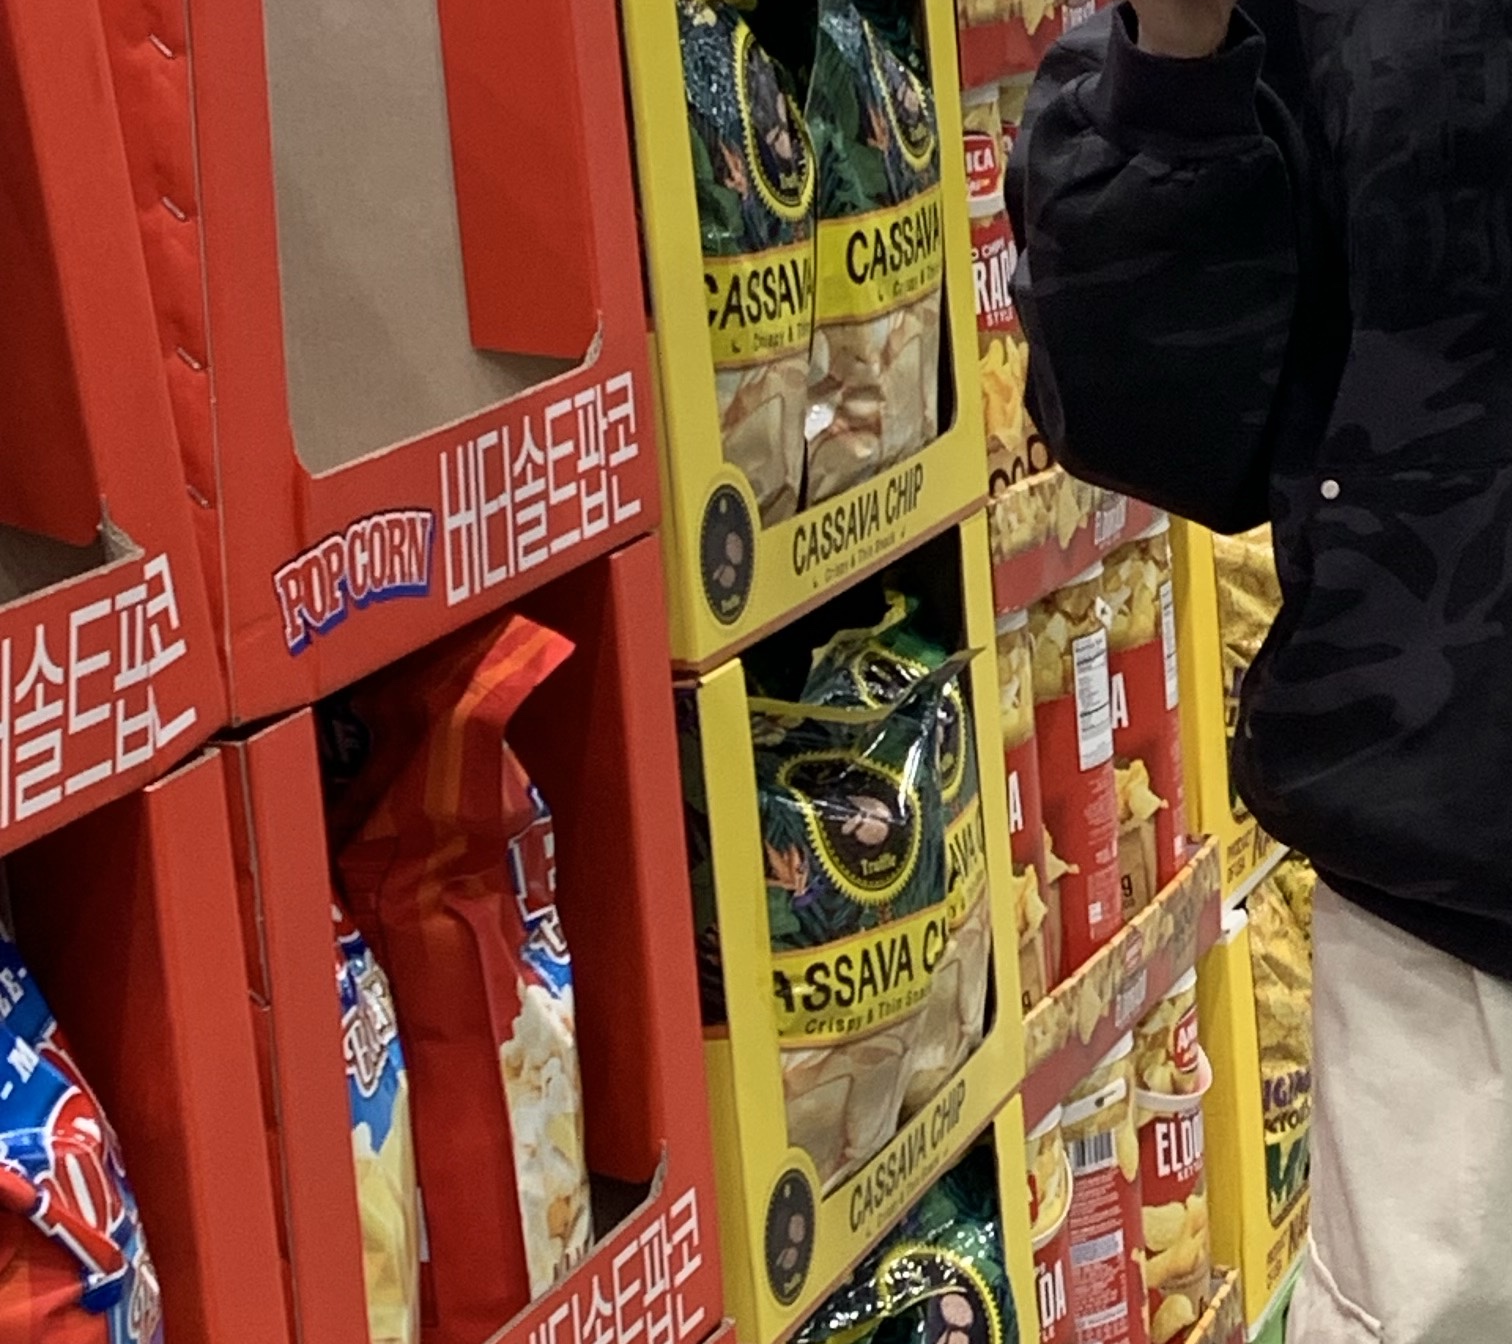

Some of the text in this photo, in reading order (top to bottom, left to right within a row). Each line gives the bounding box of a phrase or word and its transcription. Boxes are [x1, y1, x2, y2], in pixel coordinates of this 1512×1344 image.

[966, 146, 995, 174] ICA
[846, 201, 940, 285] CASSAVA
[440, 371, 642, 608] 버터솔트팝콘
[793, 488, 880, 576] CASSAVA
[884, 462, 924, 526] CHIP
[273, 510, 434, 651] POPCORN
[0, 552, 197, 829] 솔트팝콘
[773, 934, 914, 1014] ASSAVA
[850, 1121, 927, 1233] CASSAVA
[930, 1078, 966, 1150] CHIP
